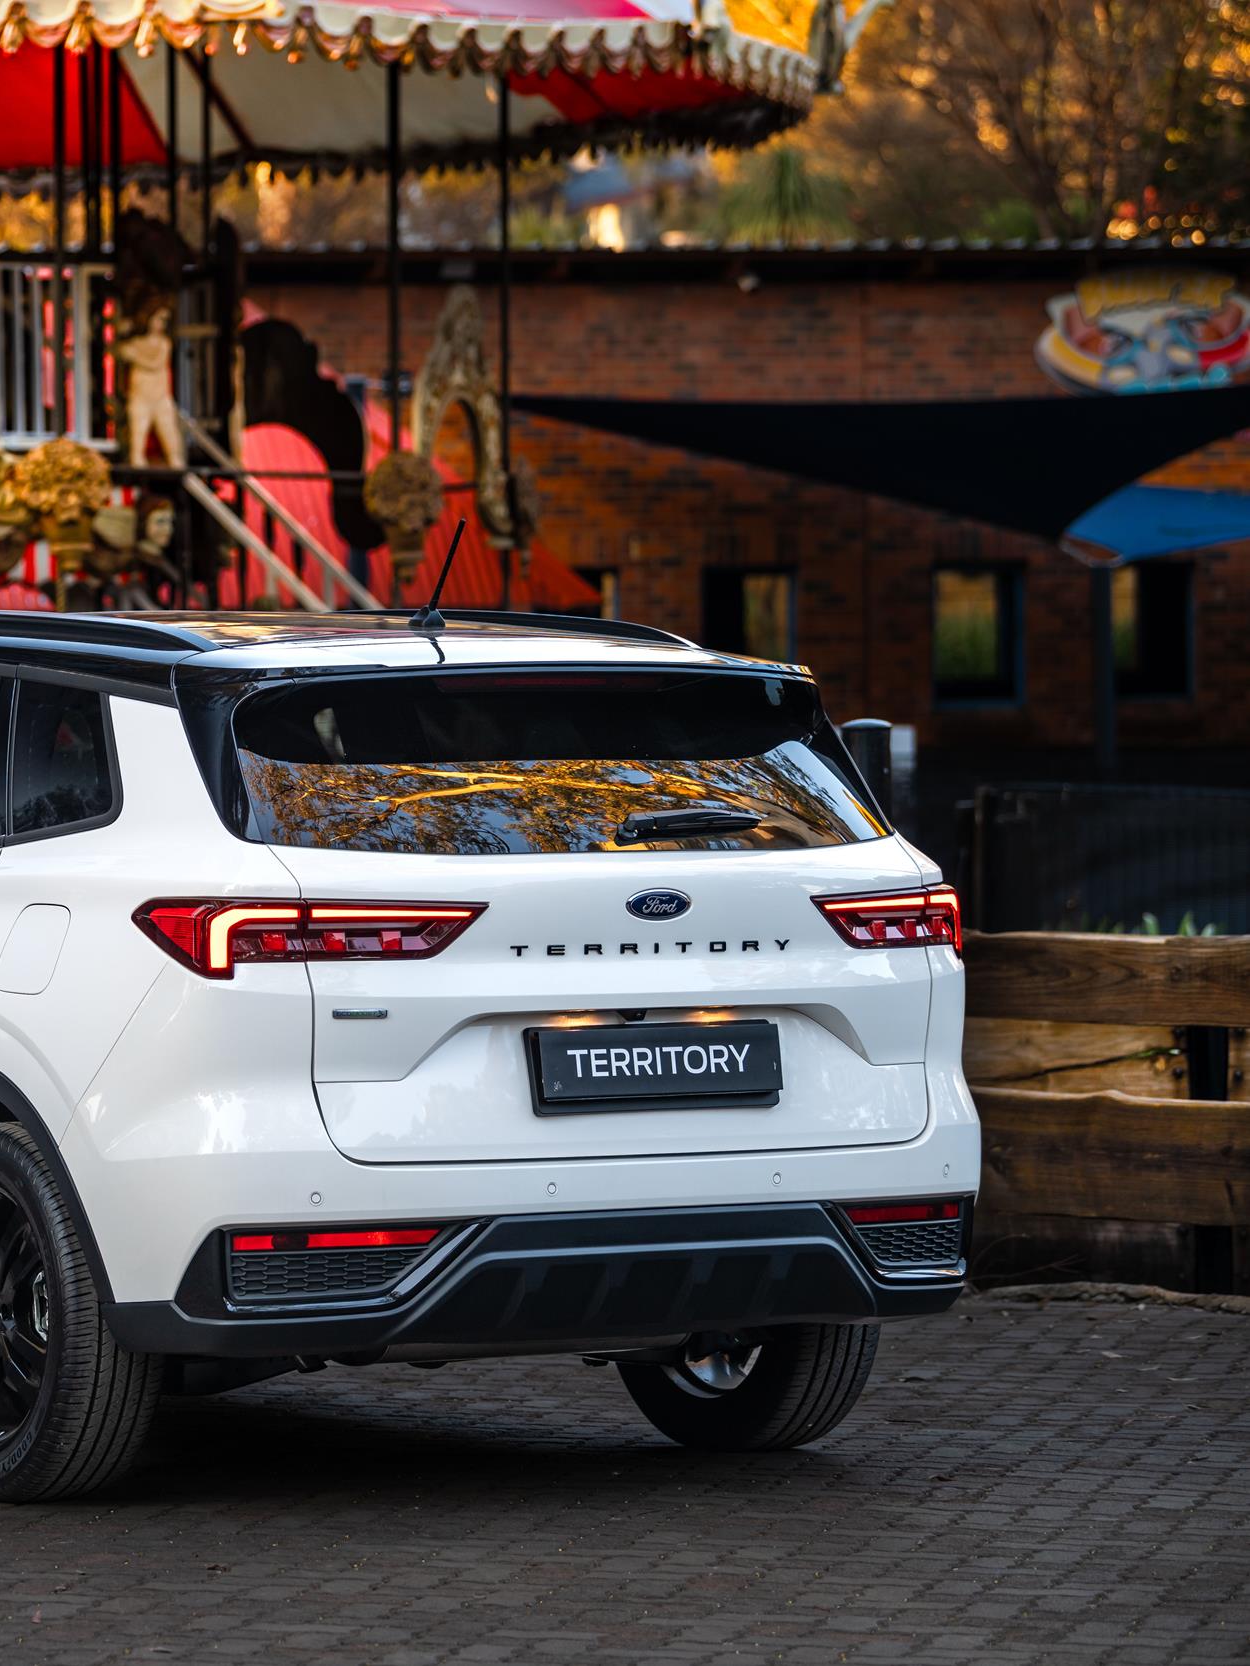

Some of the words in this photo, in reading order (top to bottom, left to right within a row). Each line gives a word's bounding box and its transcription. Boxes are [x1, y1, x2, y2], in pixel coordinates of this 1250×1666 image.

[643, 896, 678, 914] Ford
[510, 939, 790, 956] TERRITORY
[567, 1044, 750, 1078] TERRITORY
